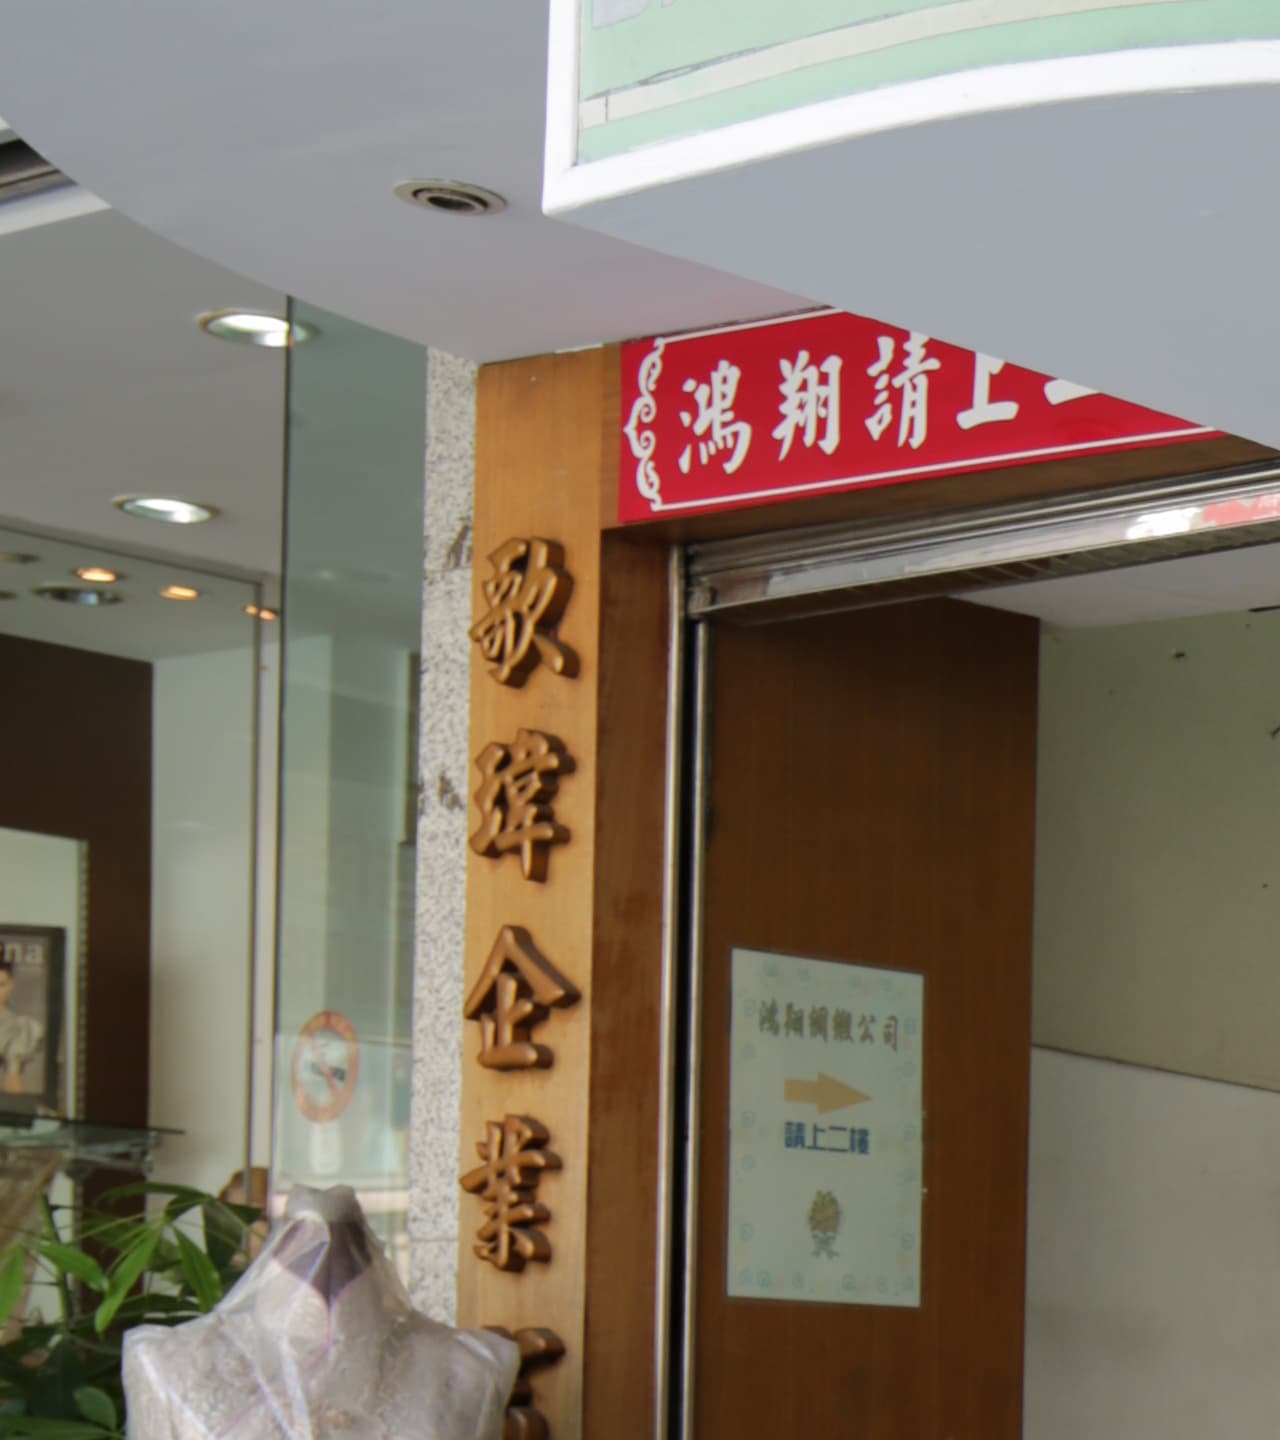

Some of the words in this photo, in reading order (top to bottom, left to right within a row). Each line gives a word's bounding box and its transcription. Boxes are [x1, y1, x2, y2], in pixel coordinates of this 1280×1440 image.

[677, 331, 1103, 476] 鴻翔請上
[783, 1120, 871, 1156] 請上二樓
